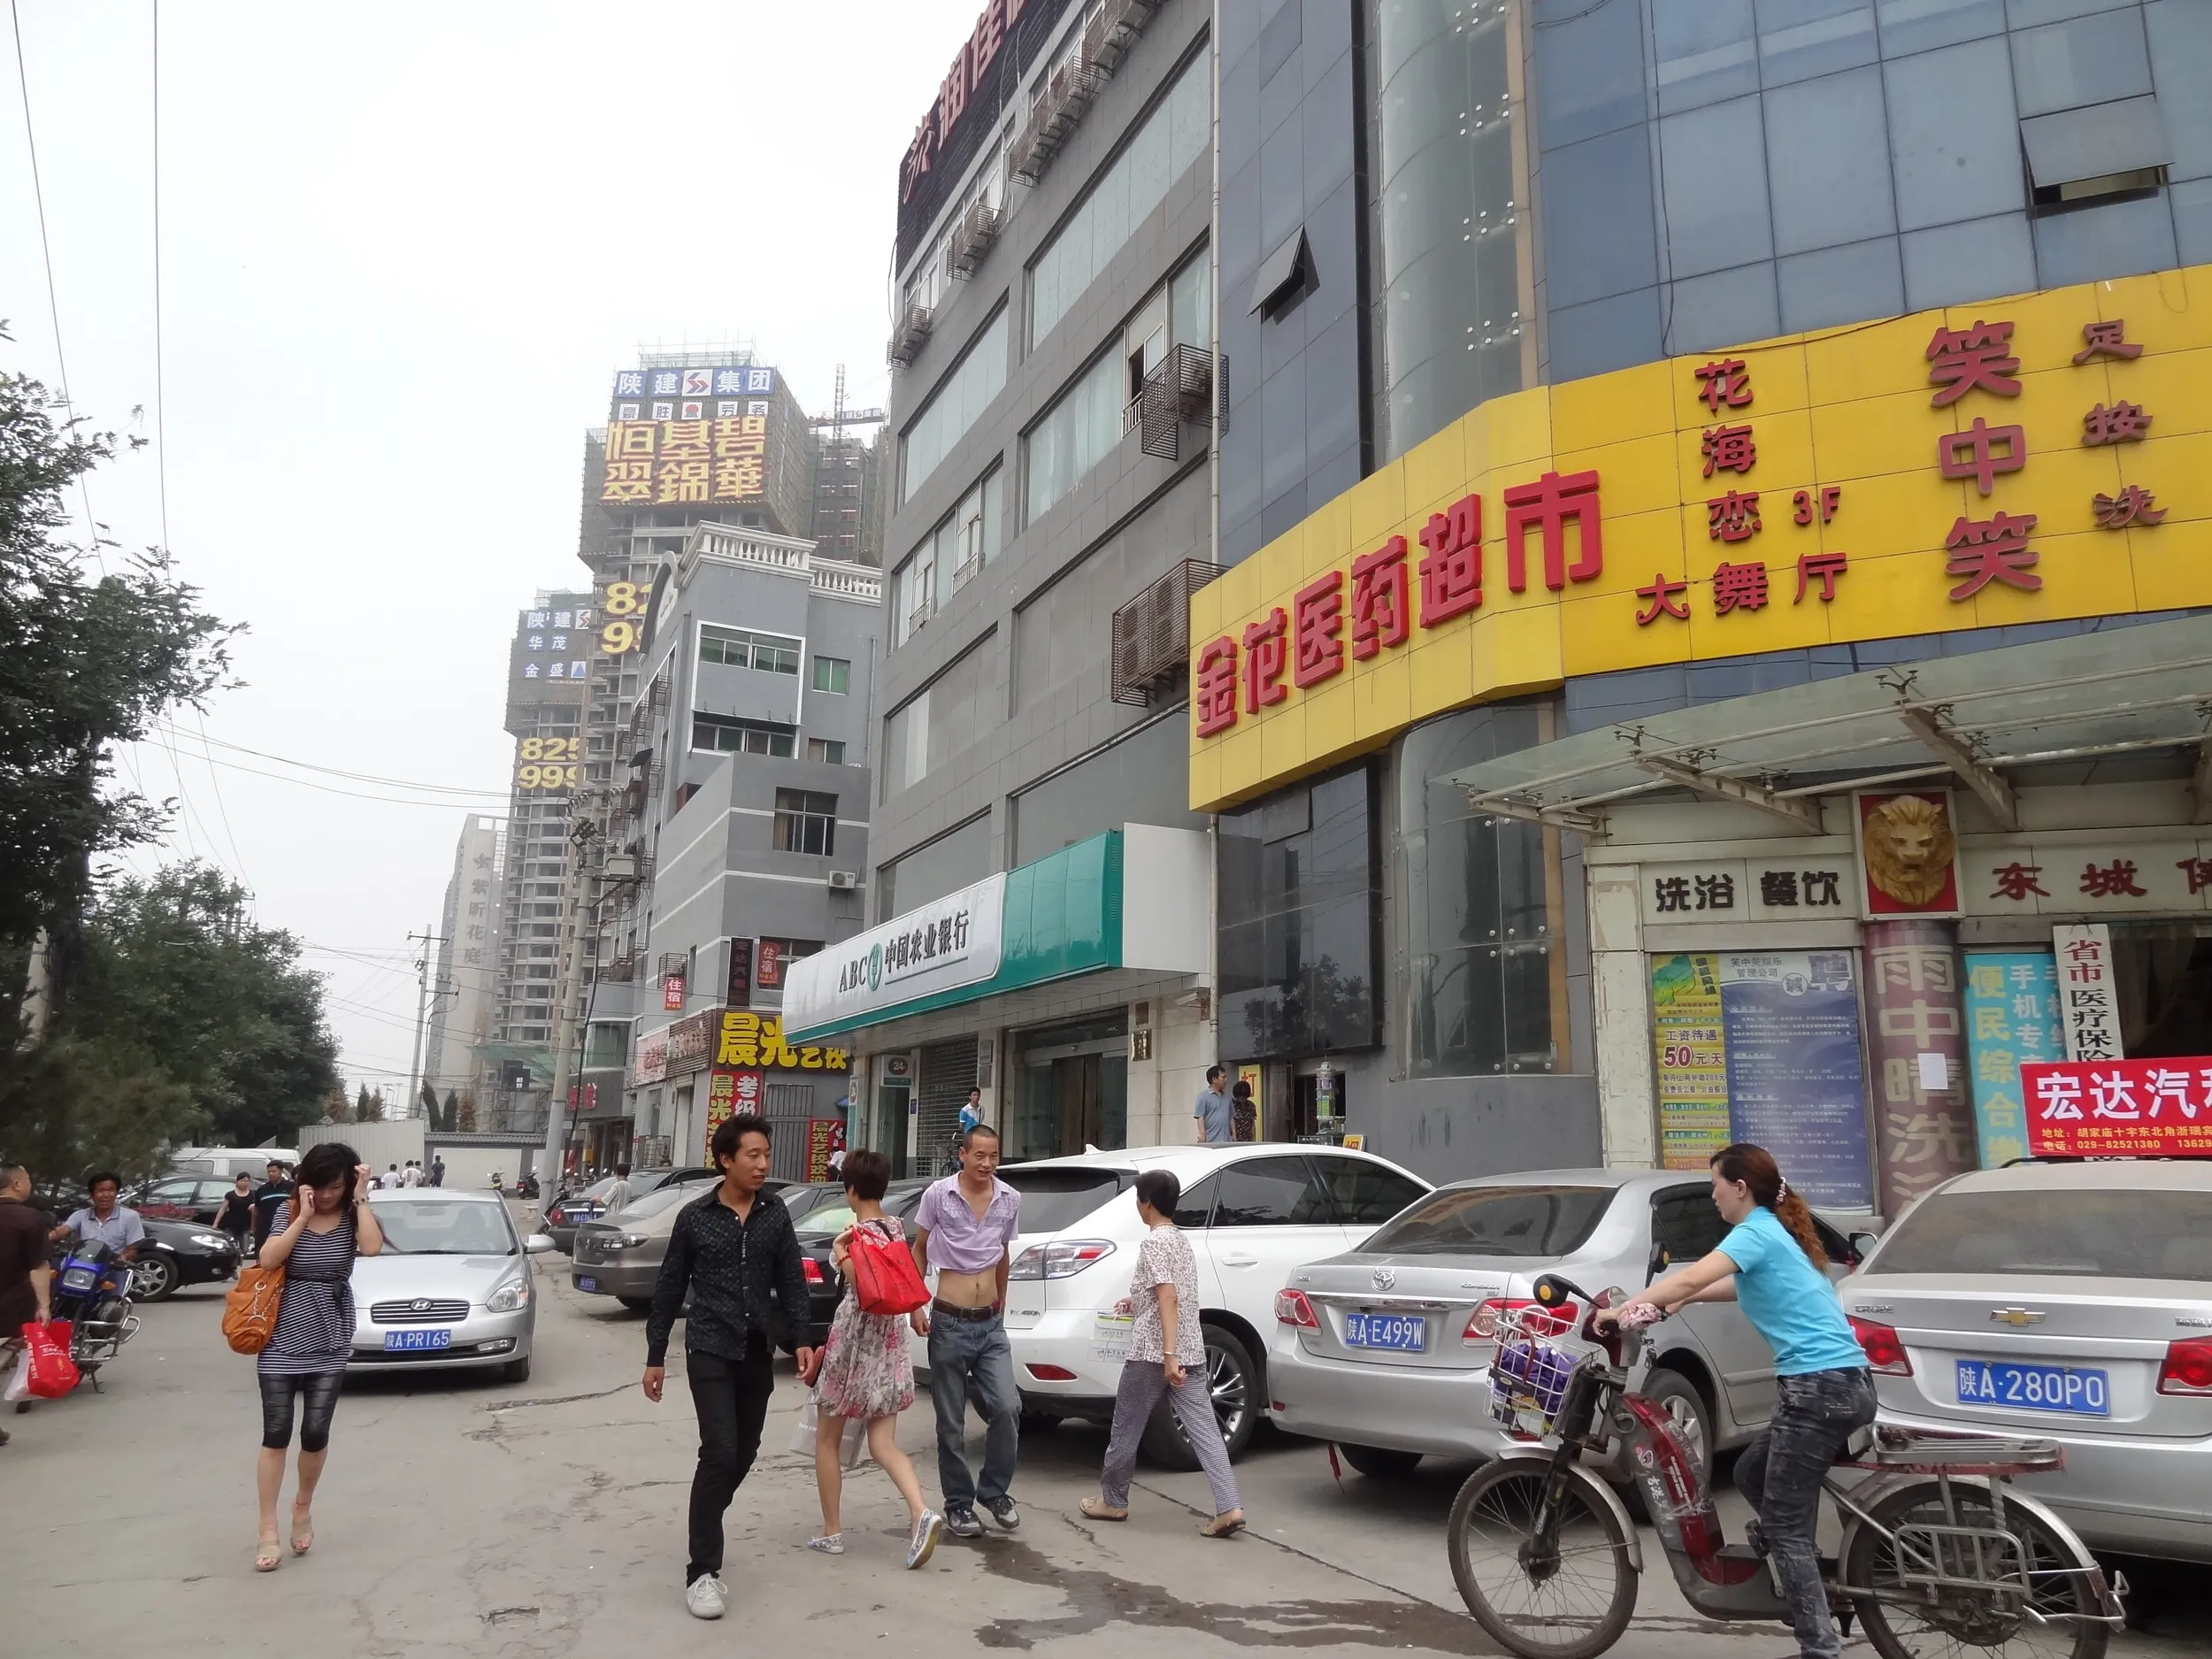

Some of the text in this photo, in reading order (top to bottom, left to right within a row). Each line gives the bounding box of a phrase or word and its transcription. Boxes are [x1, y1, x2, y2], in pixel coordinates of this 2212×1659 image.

[1694, 358, 1763, 543] 花海恋
[1926, 319, 2043, 603] 笑中笑
[1793, 487, 1841, 526] 3F
[1195, 469, 1603, 740] 金花医药超市
[1635, 552, 1848, 626] 大舞厅
[601, 621, 643, 654] 9
[1655, 871, 1841, 912] 洗浴 餐饮
[762, 947, 775, 972] 住宿
[885, 909, 969, 973] 中国农业银行
[667, 979, 682, 1002] 住宿
[839, 956, 867, 993] ABC
[1736, 968, 1778, 978] 管理公司
[2008, 964, 2046, 1063] 手机专
[1665, 1029, 1718, 1041] 工资待遇
[2036, 1068, 2212, 1120] 宏达汽
